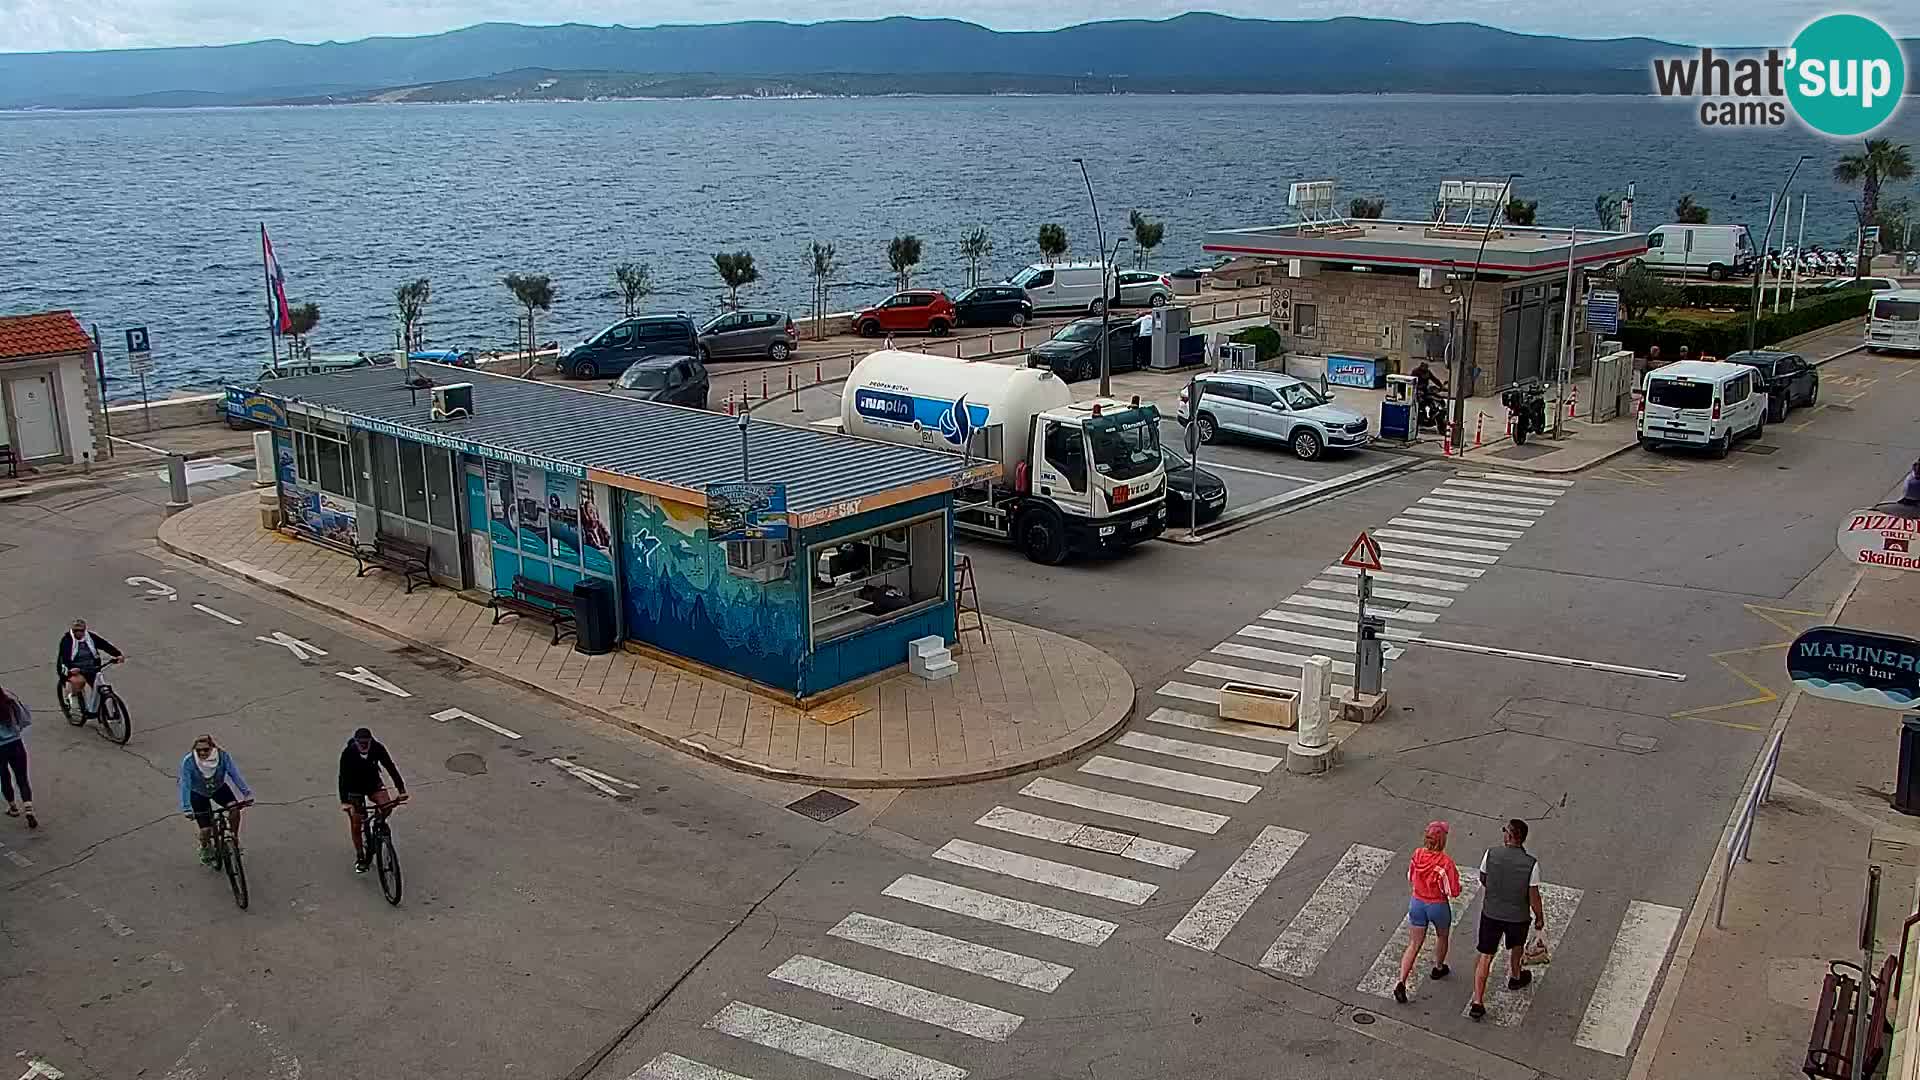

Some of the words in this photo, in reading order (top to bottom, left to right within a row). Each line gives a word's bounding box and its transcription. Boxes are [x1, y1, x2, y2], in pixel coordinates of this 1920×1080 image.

[131, 331, 144, 349] P
[397, 427, 437, 445] AUTOBUSNA
[437, 434, 469, 452] POSTAJA
[480, 446, 494, 457] BUS
[495, 450, 527, 465] STATION
[529, 457, 555, 470] TICKET
[556, 463, 583, 477] OFFICE
[1848, 515, 1920, 533] PIZZE
[1880, 530, 1917, 540] GRILL
[1828, 662, 1865, 675] caffe
[1869, 665, 1896, 681] bar
